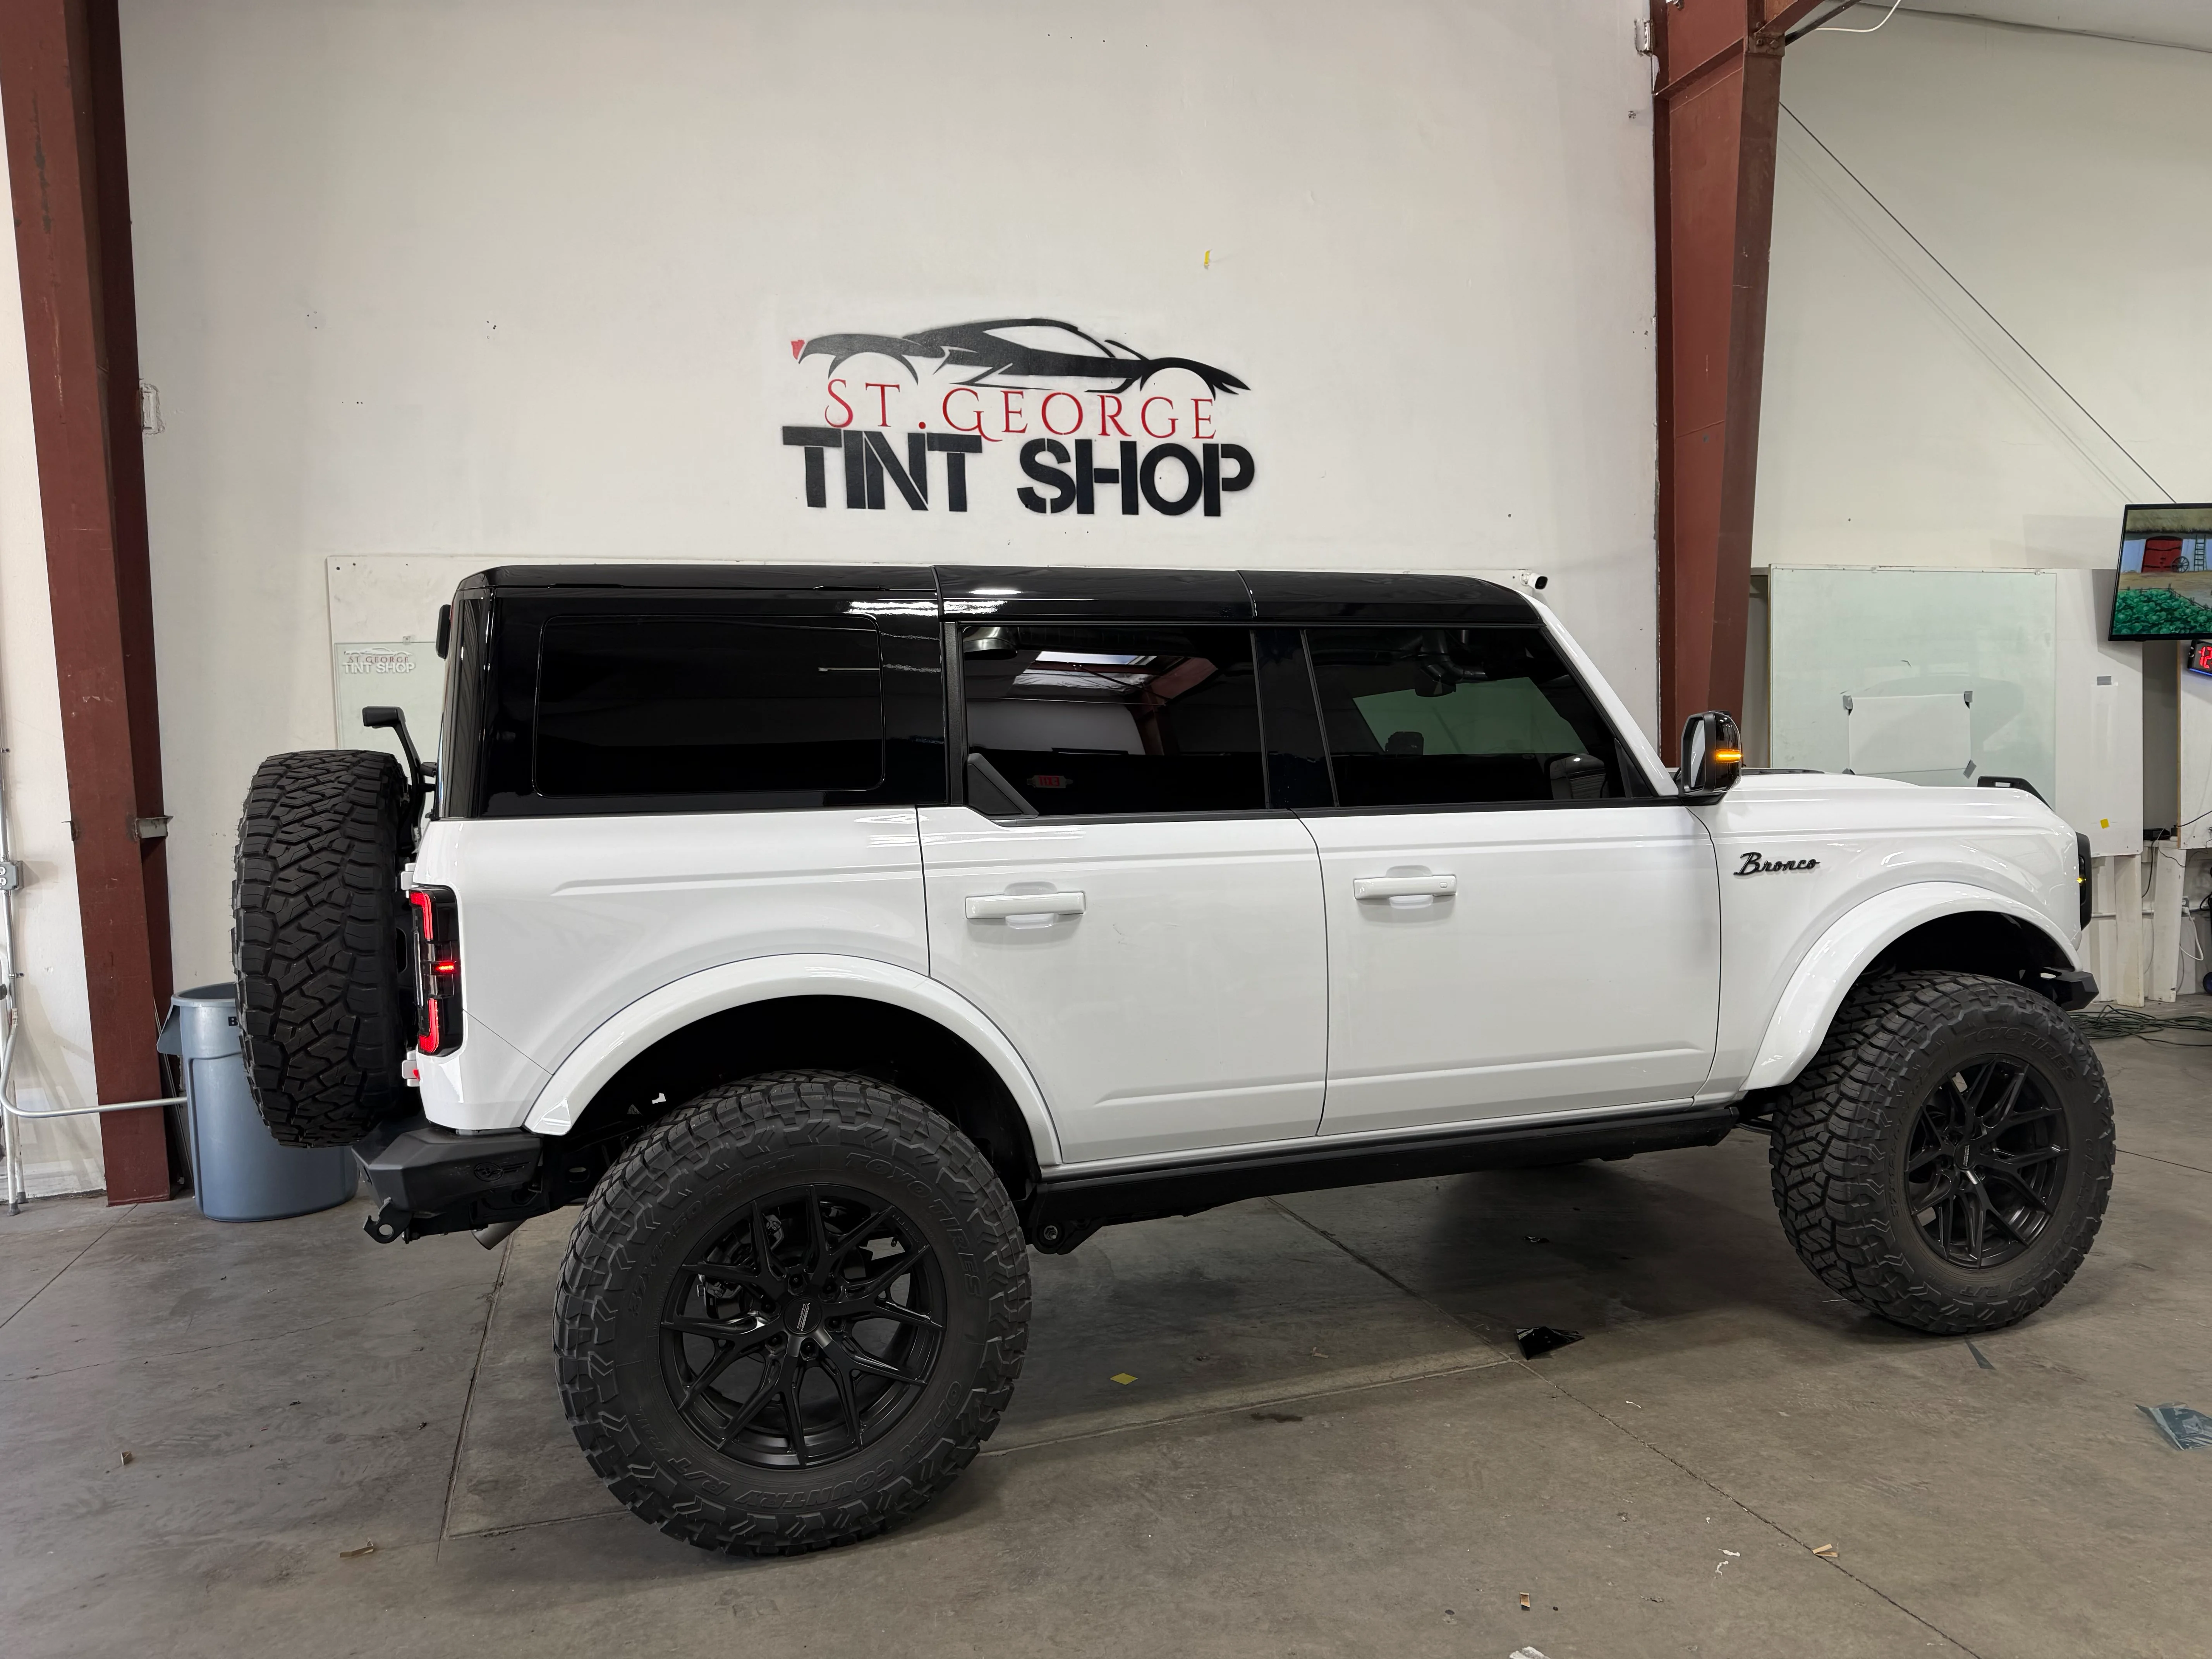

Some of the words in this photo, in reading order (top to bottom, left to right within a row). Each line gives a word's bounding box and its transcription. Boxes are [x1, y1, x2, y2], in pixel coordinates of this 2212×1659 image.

[782, 426, 983, 512] TINT
[1017, 438, 1255, 517] SHOP
[342, 662, 372, 673] TINT
[376, 662, 416, 673] SHOP
[1733, 852, 1821, 876] Bronco
[2021, 1031, 2076, 1080] TIRES
[845, 1152, 933, 1198] TOYO
[928, 1198, 981, 1298] TIRES
[1960, 1284, 2001, 1297] R/T
[900, 1381, 962, 1465] OPEN
[667, 1457, 731, 1496] R/T
[734, 1459, 894, 1509] COUNTRY
